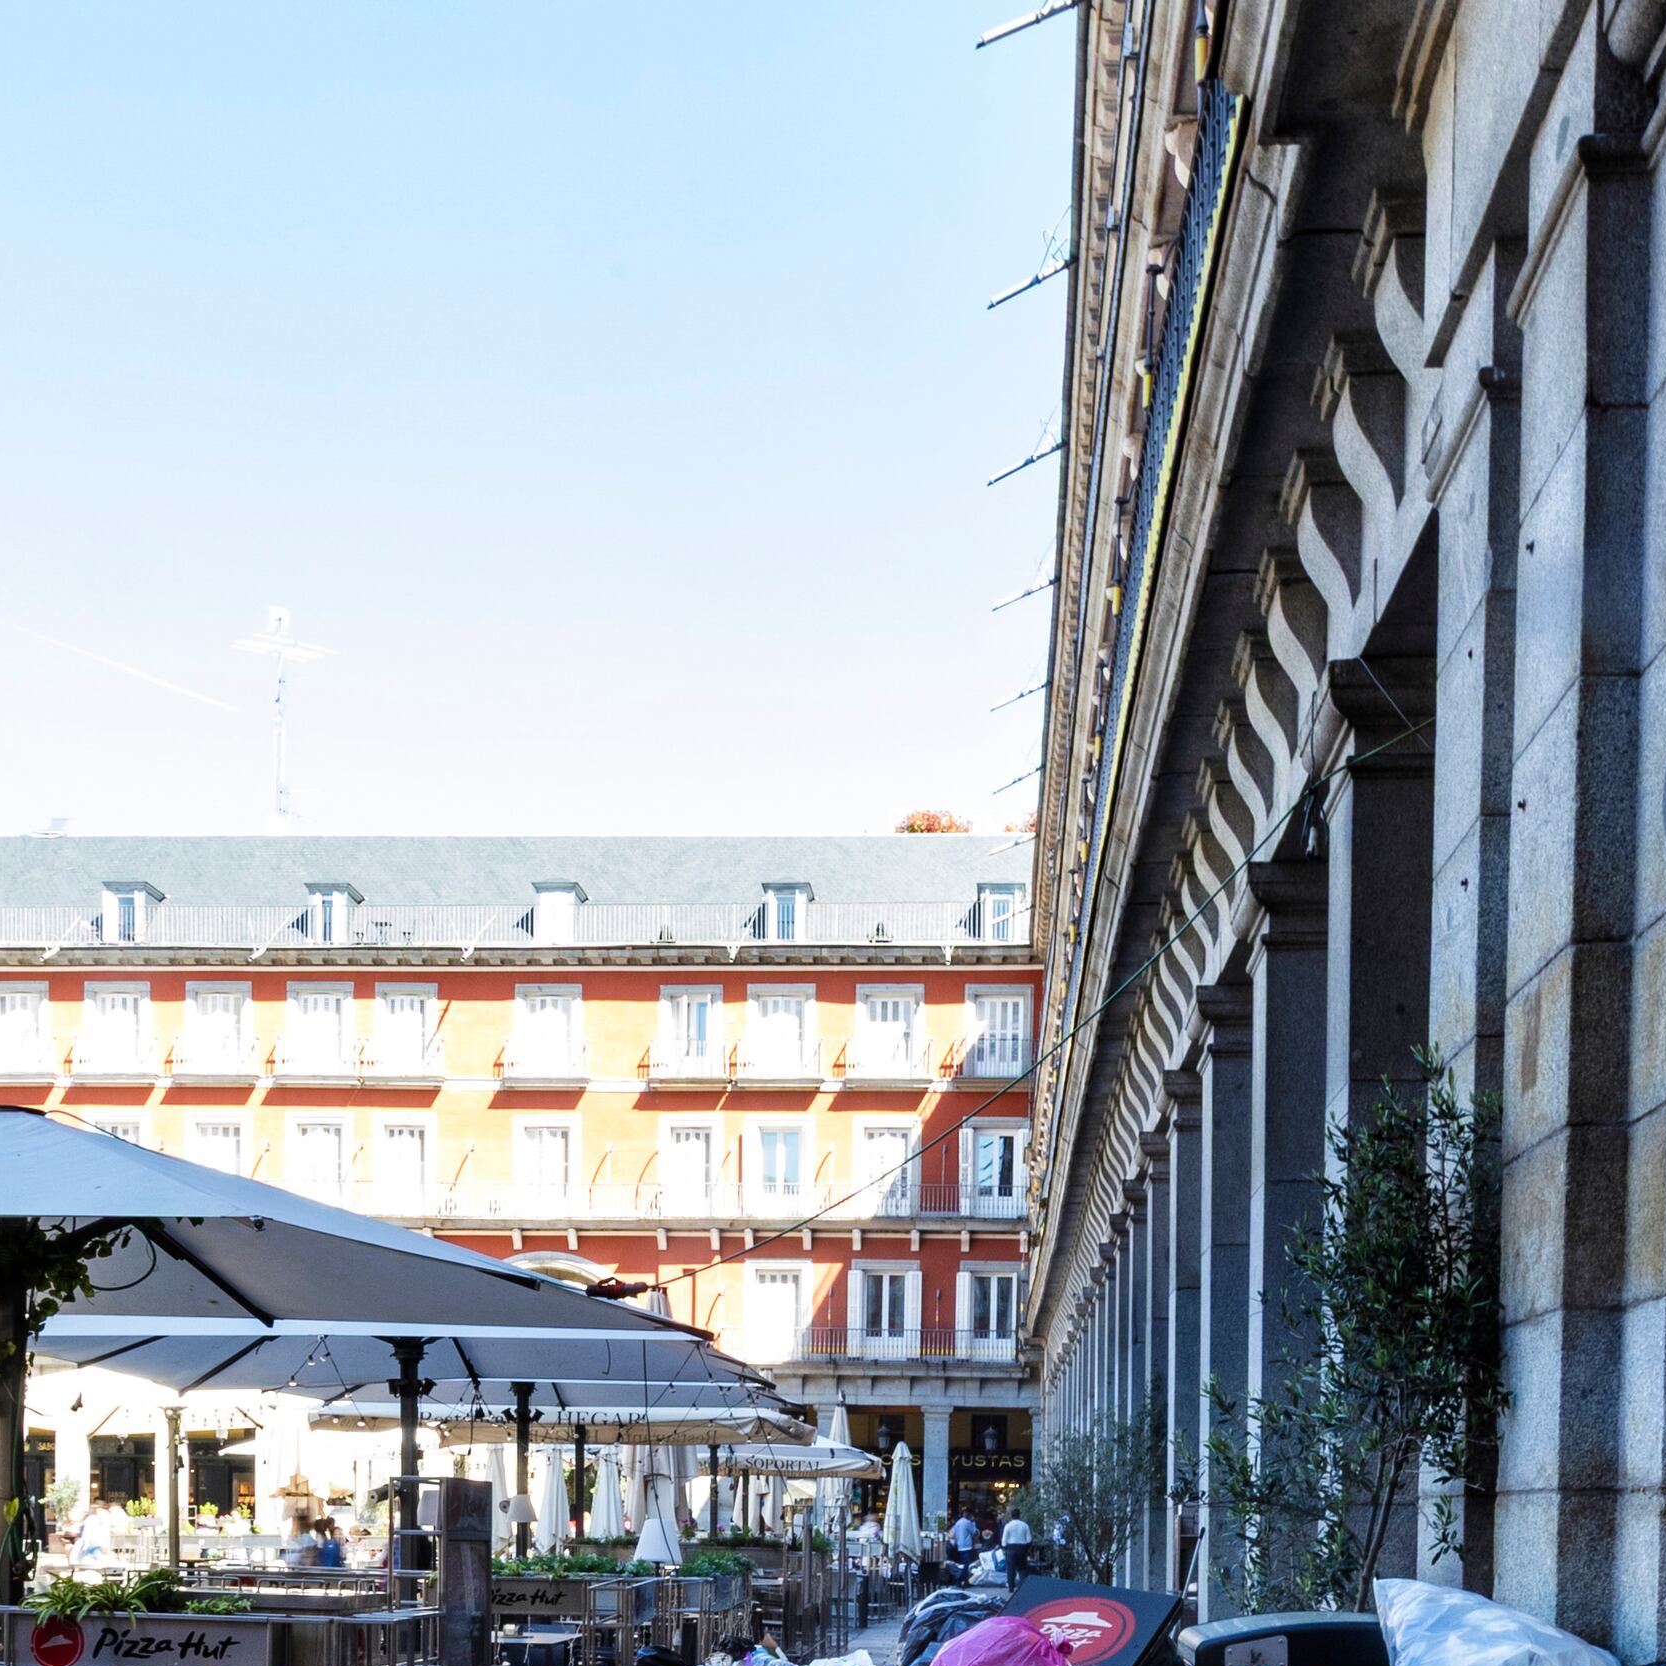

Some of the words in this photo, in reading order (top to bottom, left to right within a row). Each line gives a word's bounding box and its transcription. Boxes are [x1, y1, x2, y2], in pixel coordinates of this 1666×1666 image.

[745, 1458, 821, 1471] SOPORTAL
[950, 1455, 1025, 1467] YUSTAS
[490, 1588, 528, 1606] izza
[529, 1589, 568, 1606] Hut
[92, 1627, 175, 1660] Pizza
[172, 1630, 241, 1660] Hut
